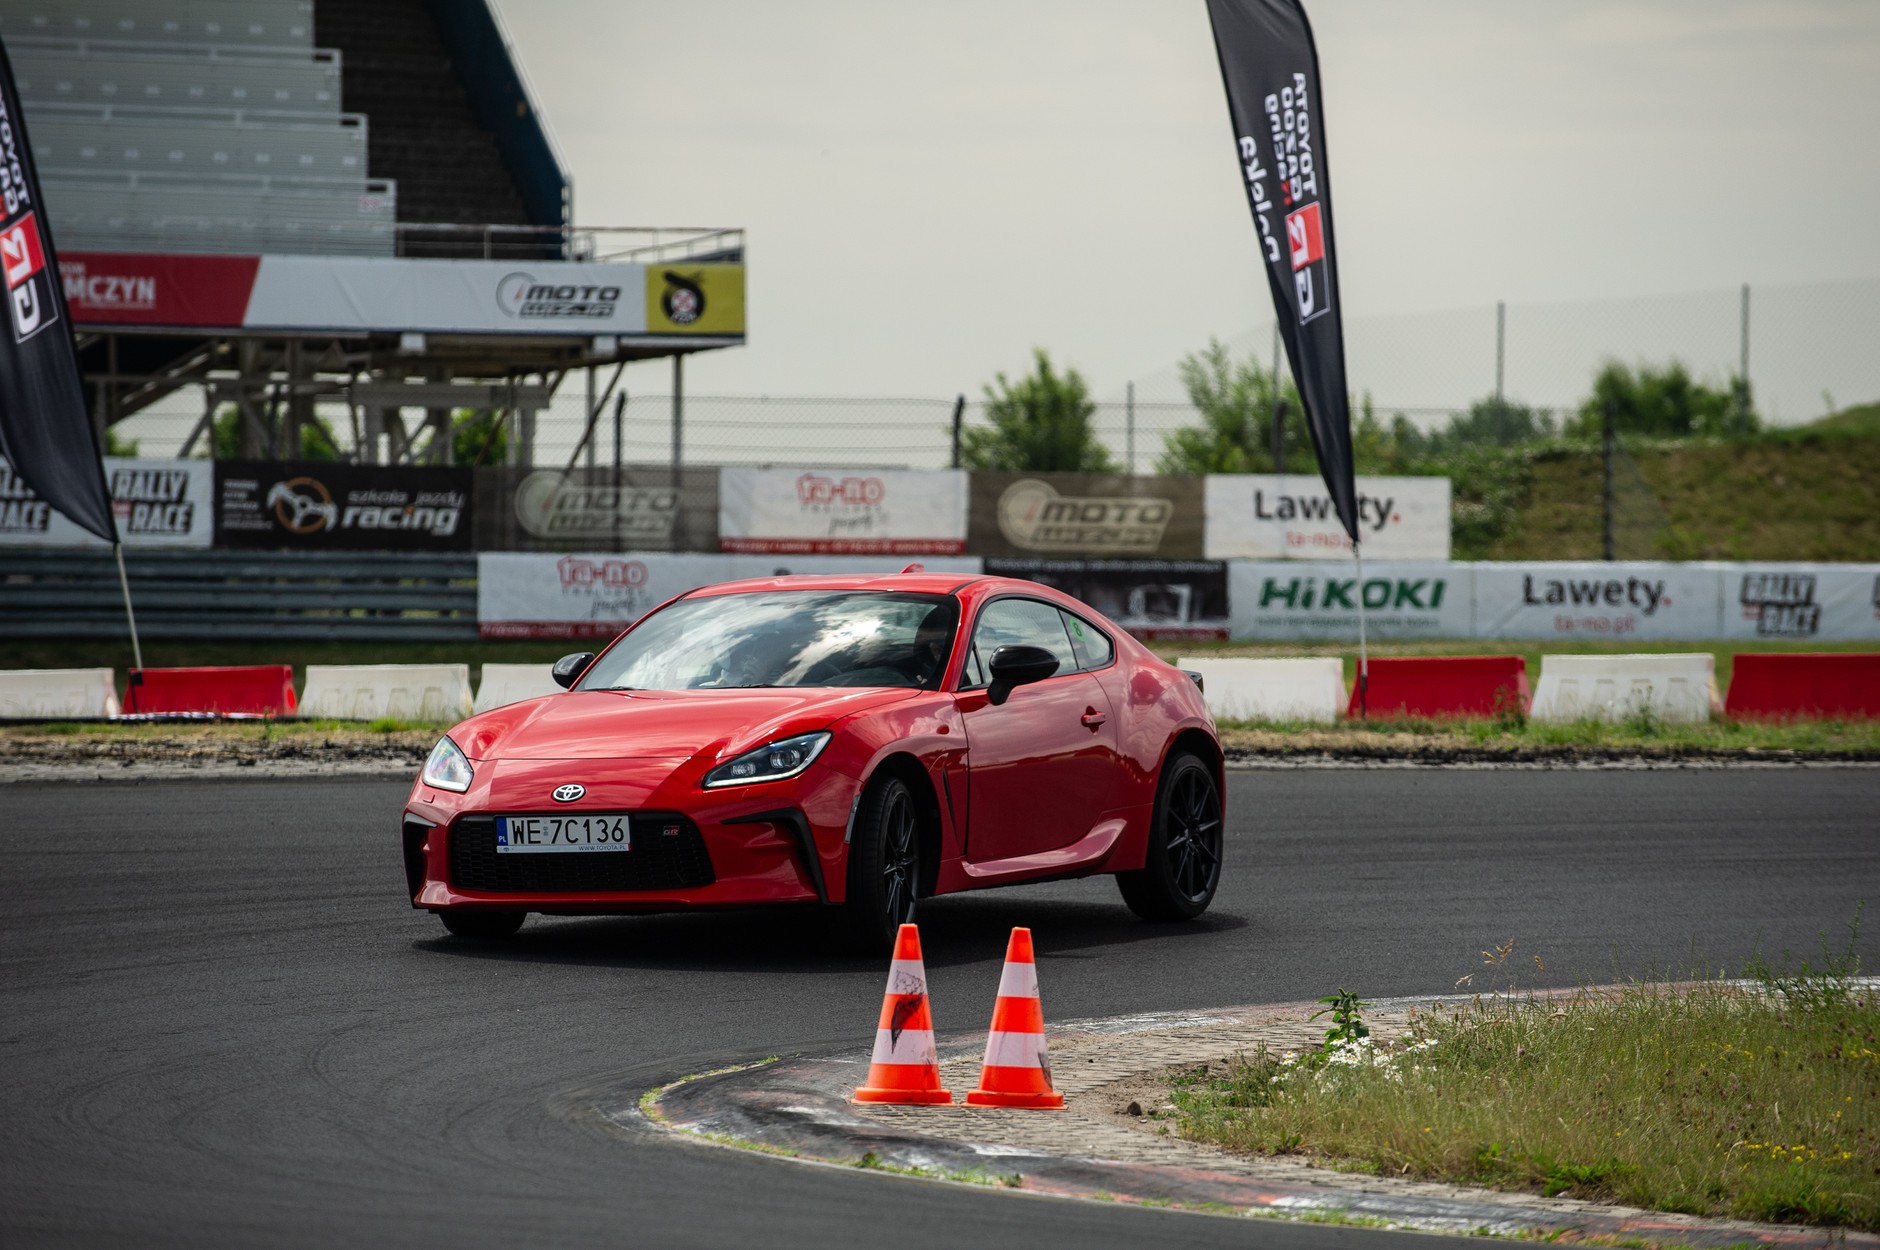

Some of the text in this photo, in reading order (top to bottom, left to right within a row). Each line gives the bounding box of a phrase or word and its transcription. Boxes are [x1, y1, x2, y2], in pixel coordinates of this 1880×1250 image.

[64, 275, 156, 301] MCZYN
[113, 470, 186, 499] RALLY
[130, 502, 191, 532] RACE
[341, 505, 460, 535] racing
[1255, 490, 1400, 531] Lawty.
[1258, 577, 1446, 609] HiKOKI
[1523, 574, 1672, 616] Lawety.
[1073, 622, 1082, 637] 8
[512, 818, 624, 844] WE 7C136
